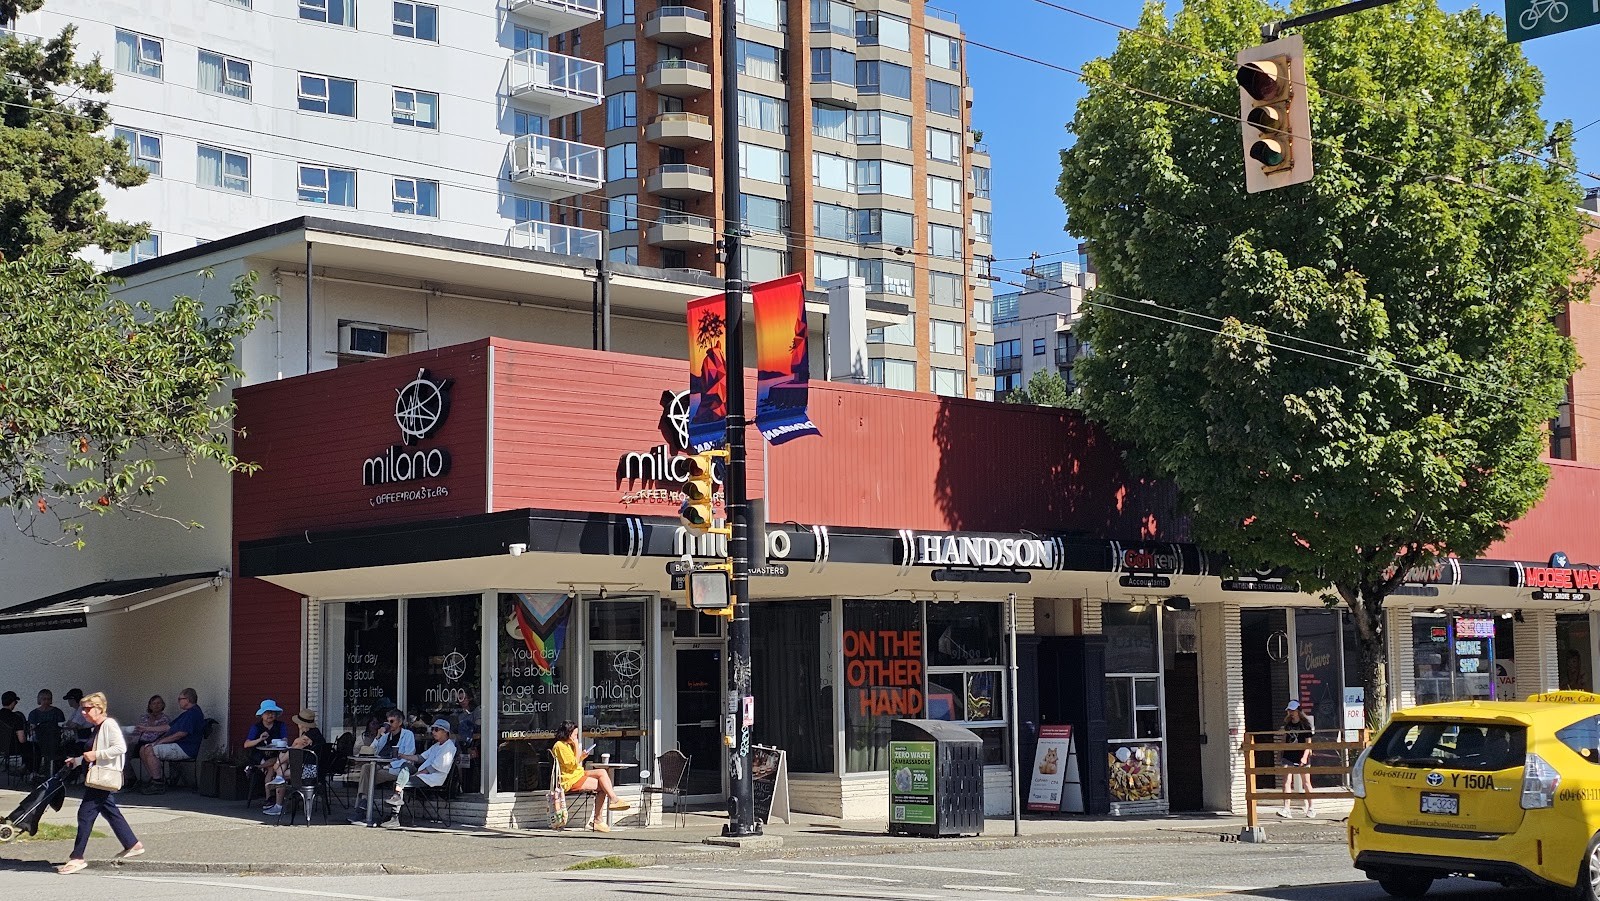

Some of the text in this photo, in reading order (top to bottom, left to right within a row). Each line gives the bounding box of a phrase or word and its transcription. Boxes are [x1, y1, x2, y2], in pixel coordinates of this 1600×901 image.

[363, 445, 443, 485] milano
[920, 534, 1053, 568] HANDSON
[1526, 567, 1600, 589] MOOSE VAP
[843, 630, 876, 657] ON
[881, 630, 921, 657] THE
[1456, 641, 1481, 655] SMOKE
[346, 651, 379, 666] Your day
[512, 646, 561, 662] Your day
[511, 664, 556, 678] is about
[1460, 658, 1480, 672] SHOP
[346, 669, 375, 681] is about
[846, 660, 922, 687] OTHER
[349, 687, 362, 701] get
[363, 689, 368, 697] a
[370, 685, 384, 698] little
[425, 683, 466, 703] milano
[502, 682, 570, 699] to get a little
[590, 680, 642, 699] milano
[502, 700, 554, 713] bit better.
[859, 689, 924, 717] HAND
[1544, 694, 1596, 703] Yellow Cab
[1347, 710, 1360, 718] FOR
[894, 751, 931, 759] ZERO WASTE
[912, 773, 928, 782] 70%
[1451, 773, 1495, 789] Y 150A
